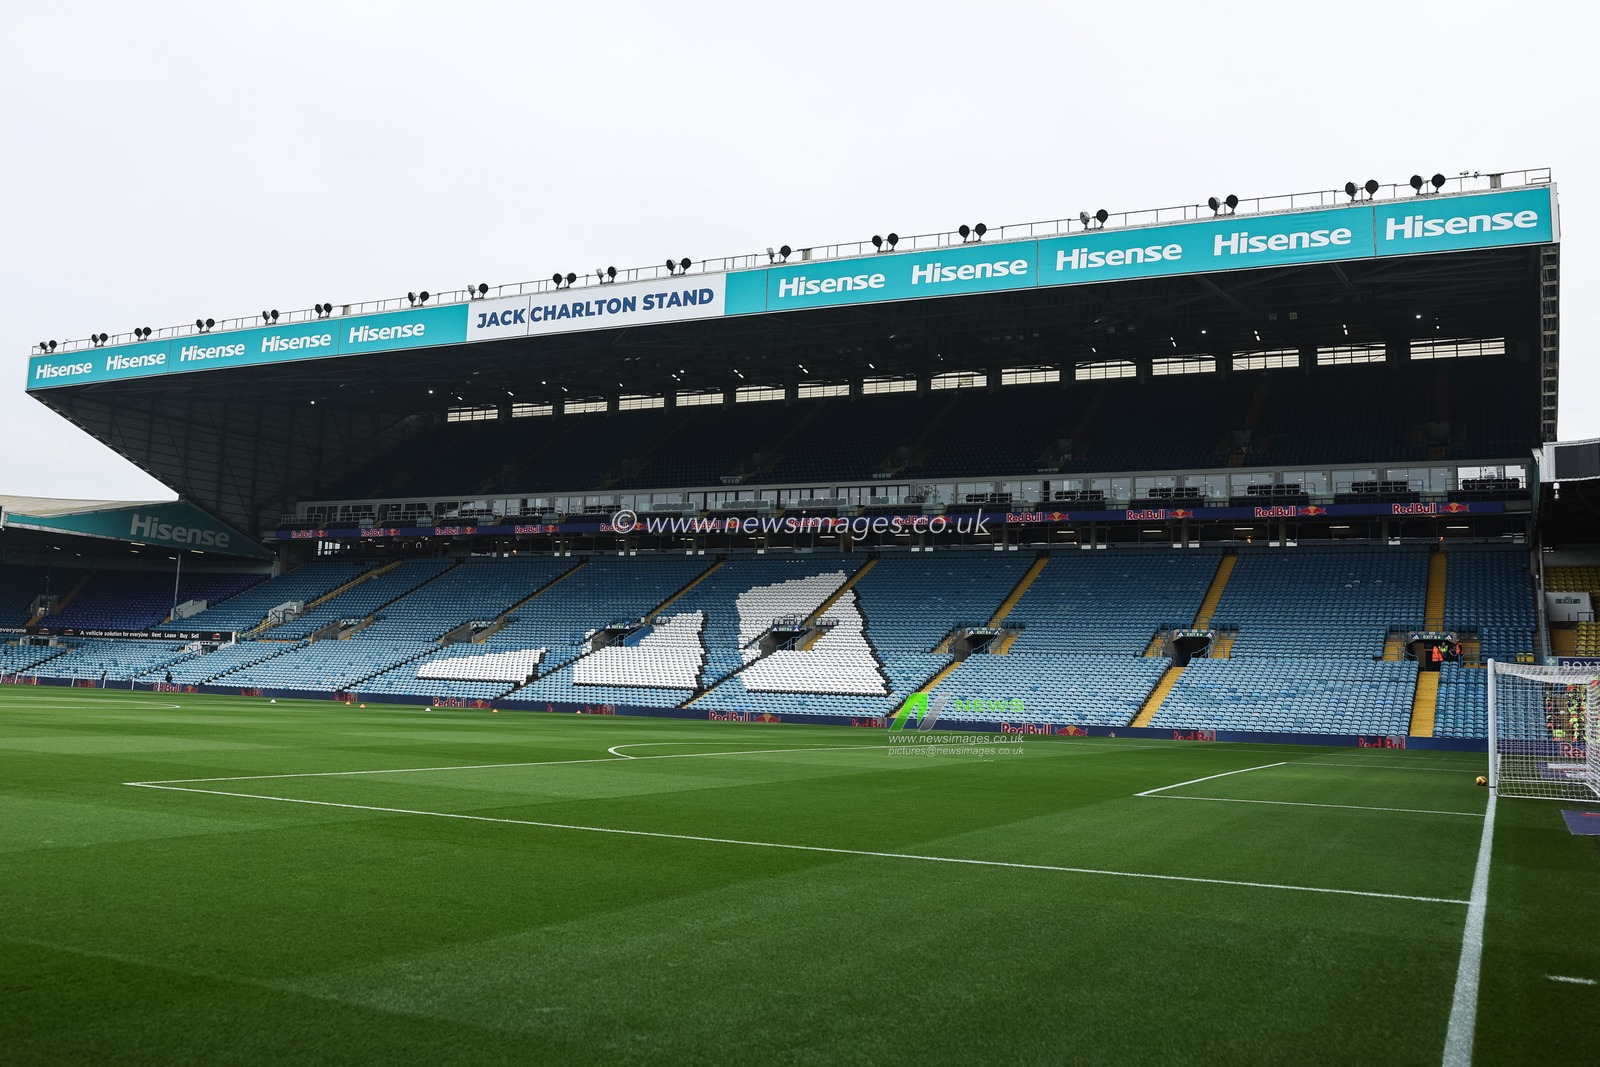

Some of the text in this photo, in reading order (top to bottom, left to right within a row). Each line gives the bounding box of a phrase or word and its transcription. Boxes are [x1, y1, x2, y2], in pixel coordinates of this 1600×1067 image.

[1385, 209, 1538, 241] Hisense
[1213, 227, 1352, 256] Hisense
[1055, 243, 1183, 271] Hisense
[911, 259, 1028, 285] Hisense
[778, 272, 885, 298] Hisense
[476, 288, 714, 329] JACK CHARLTON STAND
[261, 333, 332, 353] Hisense
[348, 323, 426, 344] Hisense
[105, 352, 166, 371] Hisense
[179, 343, 245, 362] Hisense
[35, 361, 93, 380] Hisense
[1006, 512, 1042, 522] Red Bull
[1126, 509, 1165, 520] Red Bull
[1254, 505, 1297, 517] Red Bull
[1392, 502, 1436, 514] Red Bull
[130, 513, 230, 548] Hisense
[709, 710, 750, 722] Red Bull
[1001, 722, 1052, 735] Red Bull
